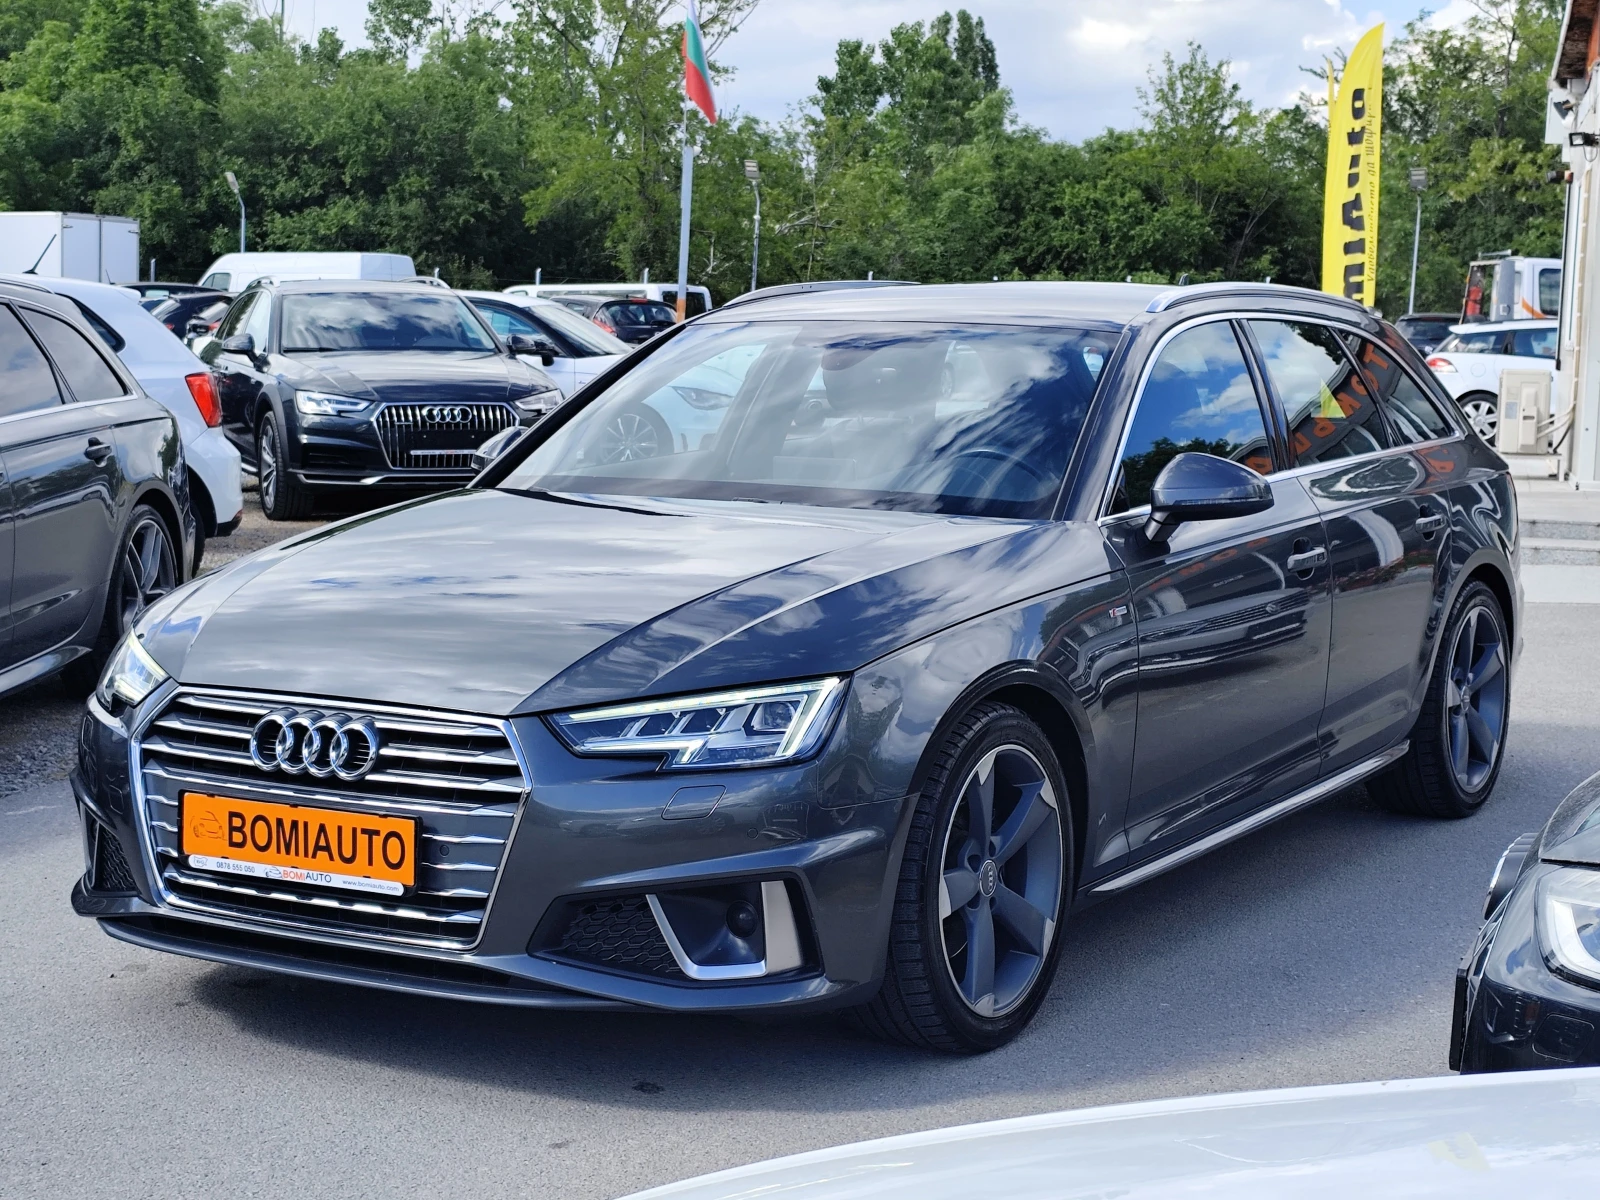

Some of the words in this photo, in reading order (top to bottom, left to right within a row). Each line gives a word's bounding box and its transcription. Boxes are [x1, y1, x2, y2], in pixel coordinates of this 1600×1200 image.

[228, 811, 406, 870] BOMIAUTO
[216, 861, 231, 870] 0878
[232, 864, 243, 872] 555
[244, 866, 255, 875] 050
[283, 870, 332, 883] BOMIAUTO
[342, 879, 400, 892] www.bomiauto.com
